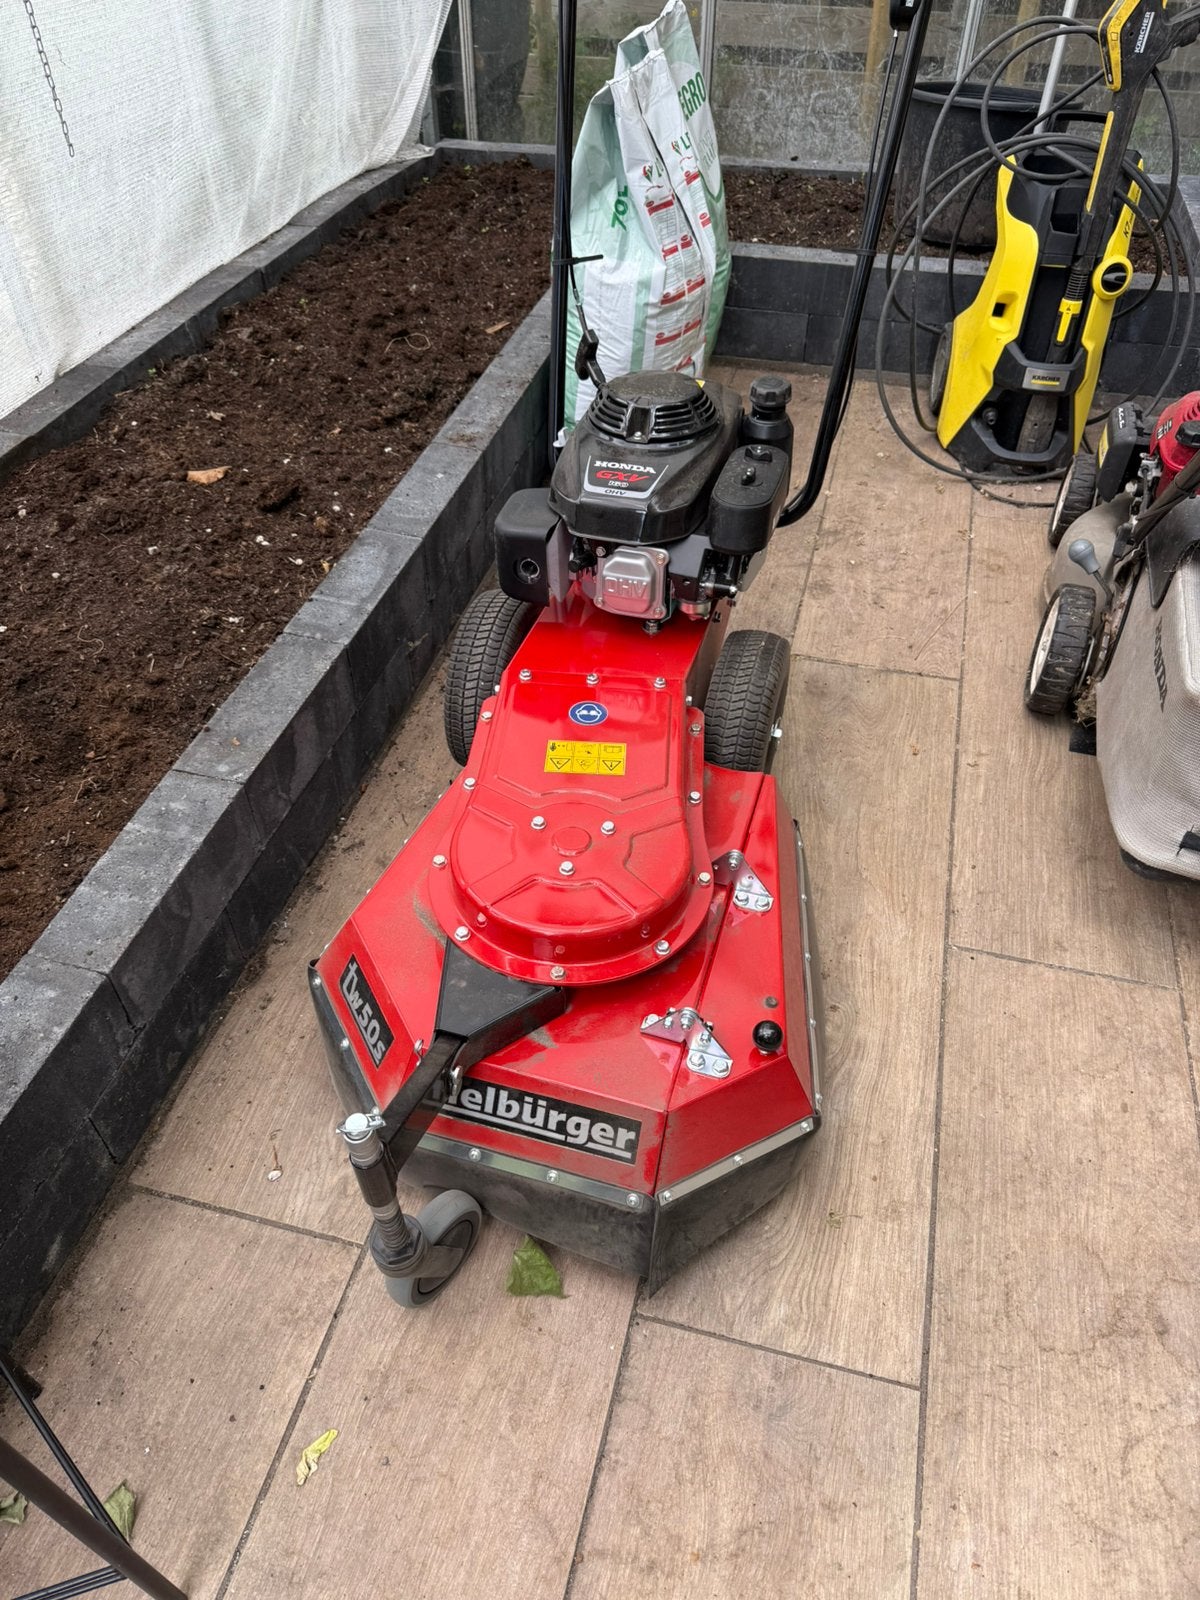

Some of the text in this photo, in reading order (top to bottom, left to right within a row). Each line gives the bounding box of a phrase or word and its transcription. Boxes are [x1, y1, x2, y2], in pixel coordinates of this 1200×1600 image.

[611, 185, 629, 231] 70L
[594, 460, 657, 474] HONDA
[595, 469, 651, 483] GXV
[604, 488, 628, 496] OHV
[605, 576, 648, 600] OHV
[1154, 615, 1168, 714] HONDA
[342, 960, 387, 1061] tw50s
